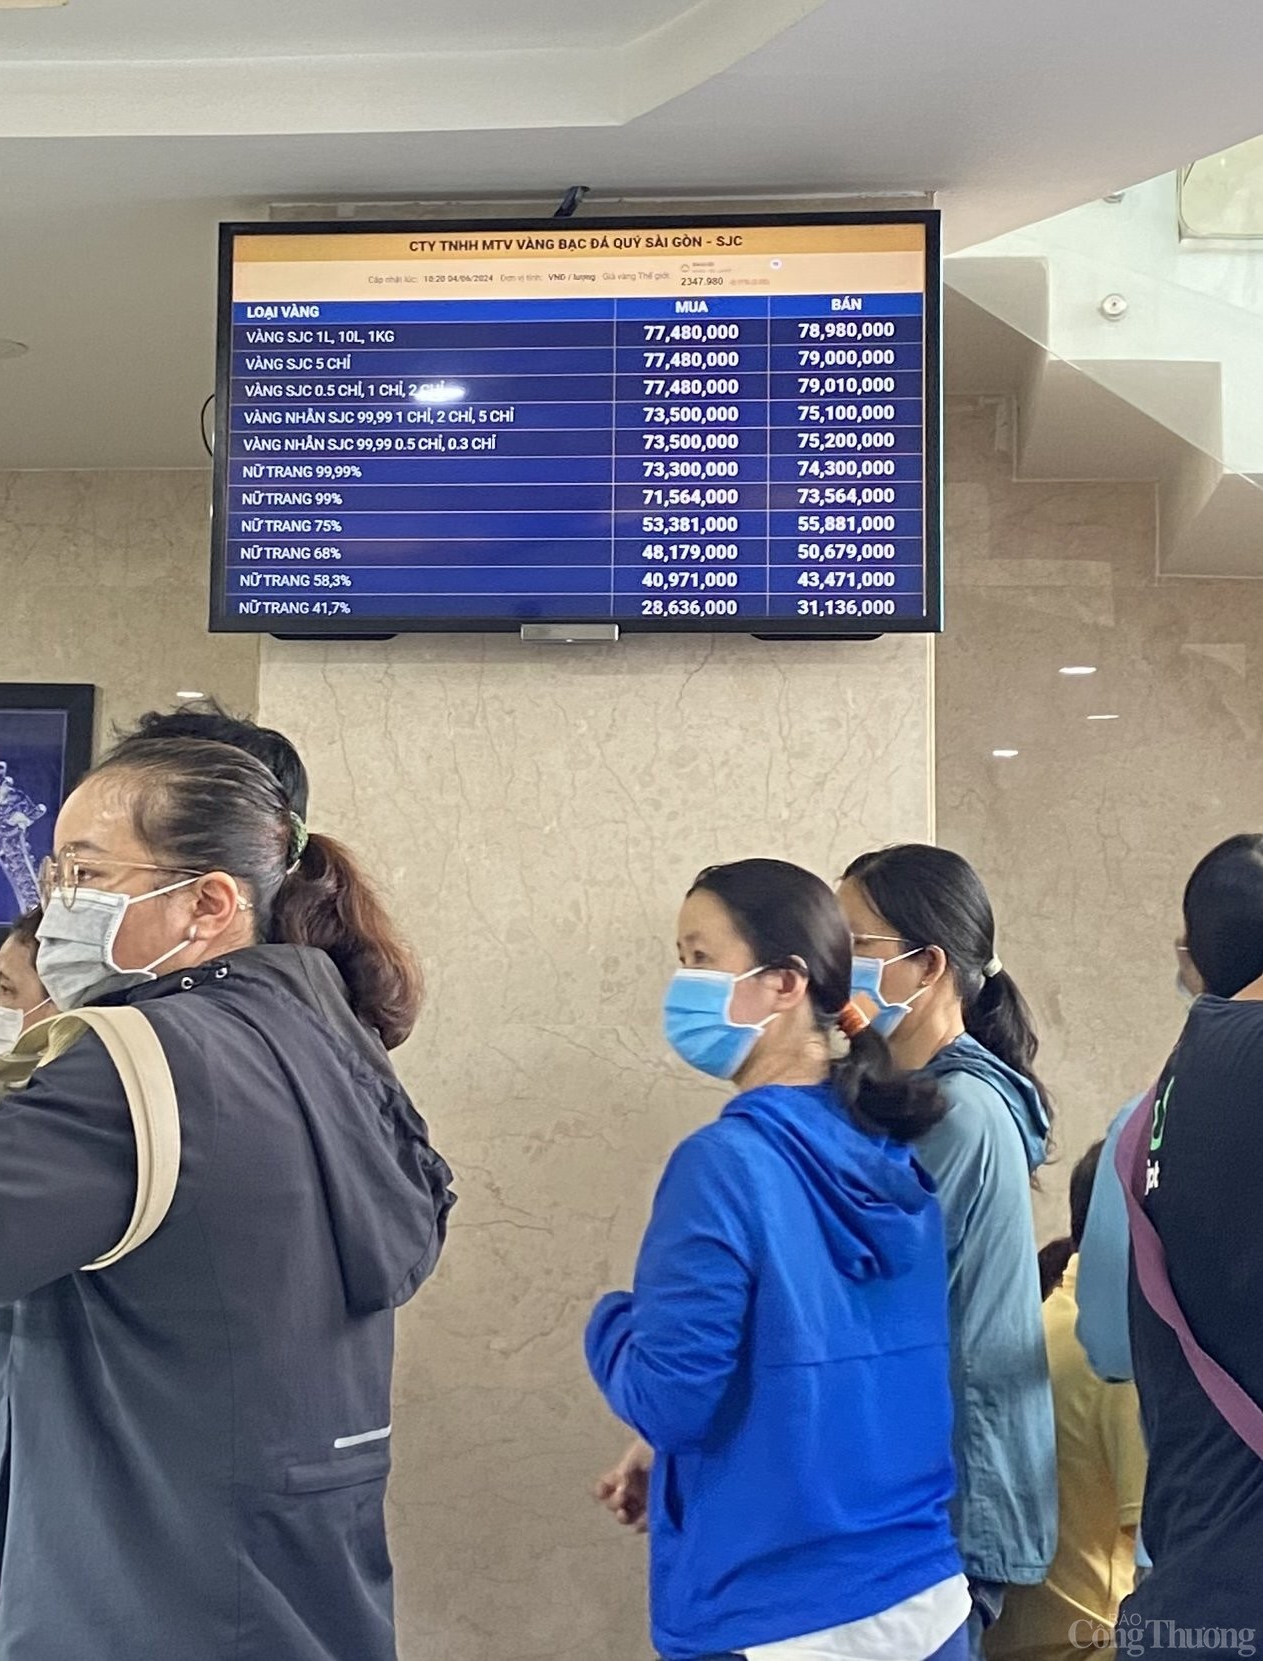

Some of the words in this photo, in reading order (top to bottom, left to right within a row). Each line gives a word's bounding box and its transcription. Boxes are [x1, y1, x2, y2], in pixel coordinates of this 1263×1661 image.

[409, 241, 436, 253] CTY
[440, 240, 479, 252] TNHH
[482, 239, 513, 250] MTV
[516, 236, 555, 250] VÀNG
[558, 238, 587, 254] BẠC
[590, 235, 610, 250] ĐÁ
[644, 233, 668, 249] SÀI
[671, 232, 703, 249] GÒN
[715, 234, 743, 248] SJC
[680, 276, 724, 287] 2347.980
[246, 306, 278, 321] LOẠI
[280, 303, 320, 318] VÀNG
[675, 300, 709, 313] MUA
[831, 296, 862, 311] BÁN
[246, 328, 285, 343] VÀNG
[287, 331, 313, 343] SJC
[316, 330, 335, 345] 1L,
[338, 330, 365, 345] 10L,
[368, 330, 395, 343] 1KG
[643, 324, 739, 343] 77,480,000
[798, 321, 895, 341] 78,980,000
[245, 355, 284, 370] VÀNG
[286, 357, 313, 370] SJC
[315, 357, 325, 370] 5
[326, 353, 351, 370] CHỈ
[643, 351, 739, 371] 77,480,000
[798, 349, 895, 369] 79,000,000
[244, 382, 283, 397] VÀNG
[285, 384, 312, 397] SJC
[314, 384, 336, 397] 0.5
[337, 380, 365, 399] CHỈ,
[367, 384, 375, 397] 1
[379, 380, 406, 398] CHỈ,
[408, 383, 418, 398] 2
[643, 378, 739, 398] 77,480,000
[797, 376, 895, 396] 79,010,000
[243, 409, 283, 424] VÀNG
[285, 407, 326, 424] NHẪN
[327, 411, 355, 424] SJC
[357, 410, 393, 425] 99,99
[395, 411, 403, 423] 1
[407, 406, 434, 425] CHỈ,
[436, 410, 446, 423] 2
[448, 406, 476, 425] CHỈ,
[478, 410, 488, 423] 5
[489, 406, 515, 423] CHỈ
[642, 406, 739, 425] 73,500,000
[797, 404, 895, 424] 75,100,000
[243, 436, 282, 451] VÀNG
[284, 434, 325, 451] NHẪN
[327, 438, 354, 451] SJC
[356, 437, 392, 452] 99,99
[394, 437, 416, 451] 0.5
[417, 433, 446, 452] CHỈ,
[447, 437, 469, 450] 0.3
[471, 433, 497, 450] CHỈ
[642, 433, 739, 453] 73,500,000
[797, 432, 895, 452] 75,200,000
[242, 463, 266, 478] NỮ
[265, 465, 313, 478] TRANG
[315, 465, 363, 480] 99,99%
[642, 461, 739, 480] 73,300,000
[797, 459, 895, 479] 74,300,000
[241, 490, 266, 505] NỮ
[265, 492, 313, 505] TRANG
[314, 492, 343, 505] 99%
[642, 488, 739, 508] 71,564,000
[796, 487, 895, 507] 73,564,000
[241, 517, 264, 532] NỮ
[264, 519, 312, 532] TRANG
[314, 519, 342, 532] 75%
[642, 516, 738, 535] 53,381,000
[797, 515, 895, 535] 55,881,000
[240, 544, 263, 560] NỮ
[264, 546, 311, 560] TRANG
[313, 547, 342, 560] 68%
[641, 544, 738, 563] 48,179,000
[797, 543, 895, 562] 50,679,000
[240, 571, 263, 587] NỮ
[263, 574, 311, 587] TRANG
[313, 574, 352, 589] 58,3%
[641, 571, 738, 591] 40,971,000
[797, 571, 895, 590] 43,471,000
[239, 599, 262, 614] NỮ
[262, 601, 310, 614] TRANG
[312, 601, 351, 616] 41,7%
[641, 599, 738, 617] 28,636,000
[797, 599, 895, 617] 31,136,000
